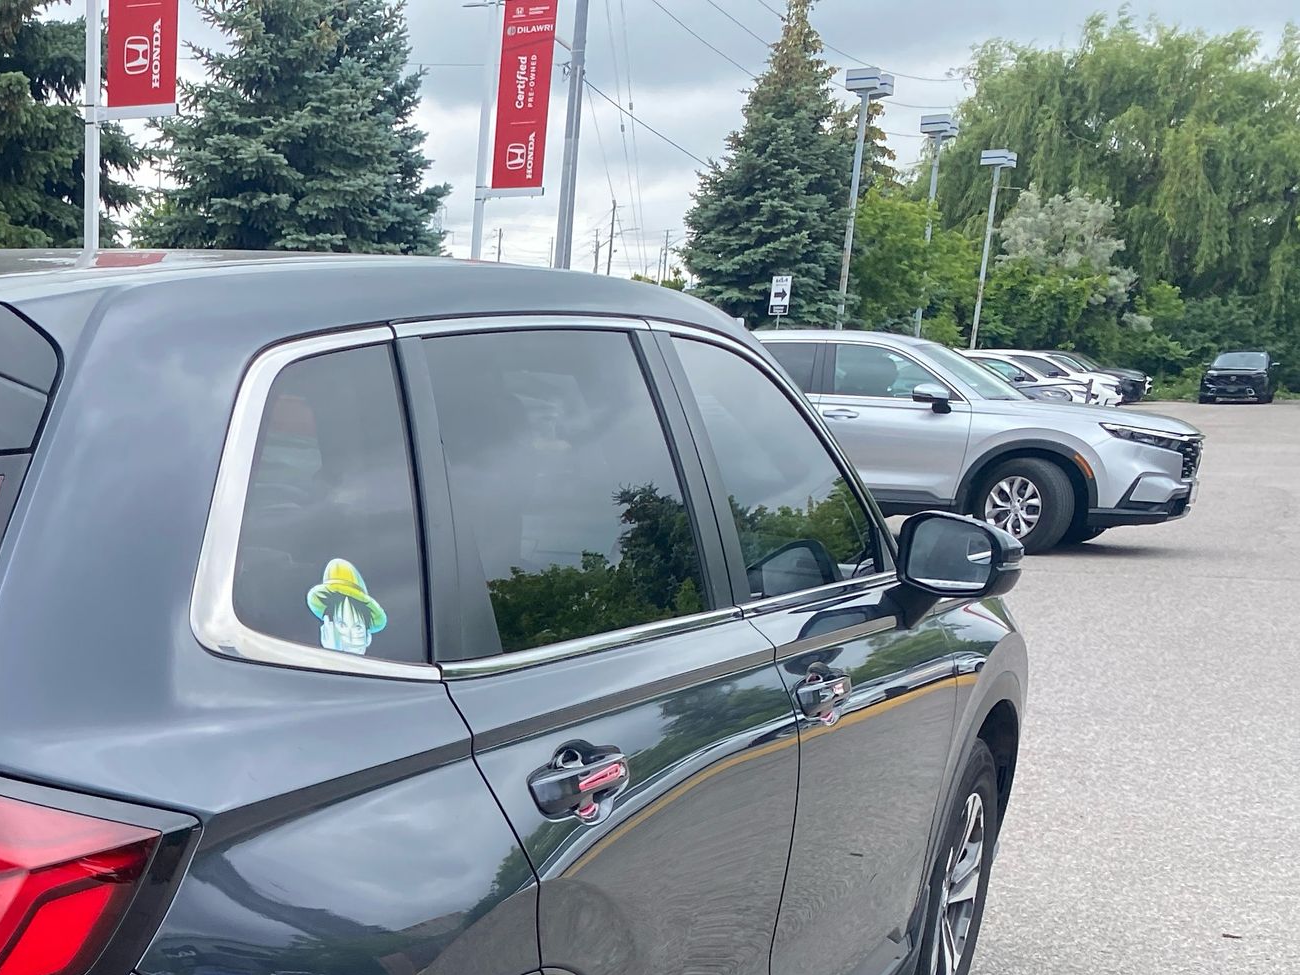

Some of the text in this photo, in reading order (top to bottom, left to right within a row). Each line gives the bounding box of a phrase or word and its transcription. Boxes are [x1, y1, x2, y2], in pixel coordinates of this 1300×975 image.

[151, 18, 162, 89] HONDA
[516, 24, 554, 34] DILAWRI
[515, 55, 528, 109] Certified
[527, 54, 538, 108] PRE-OWNED
[525, 131, 537, 179] HONDA
